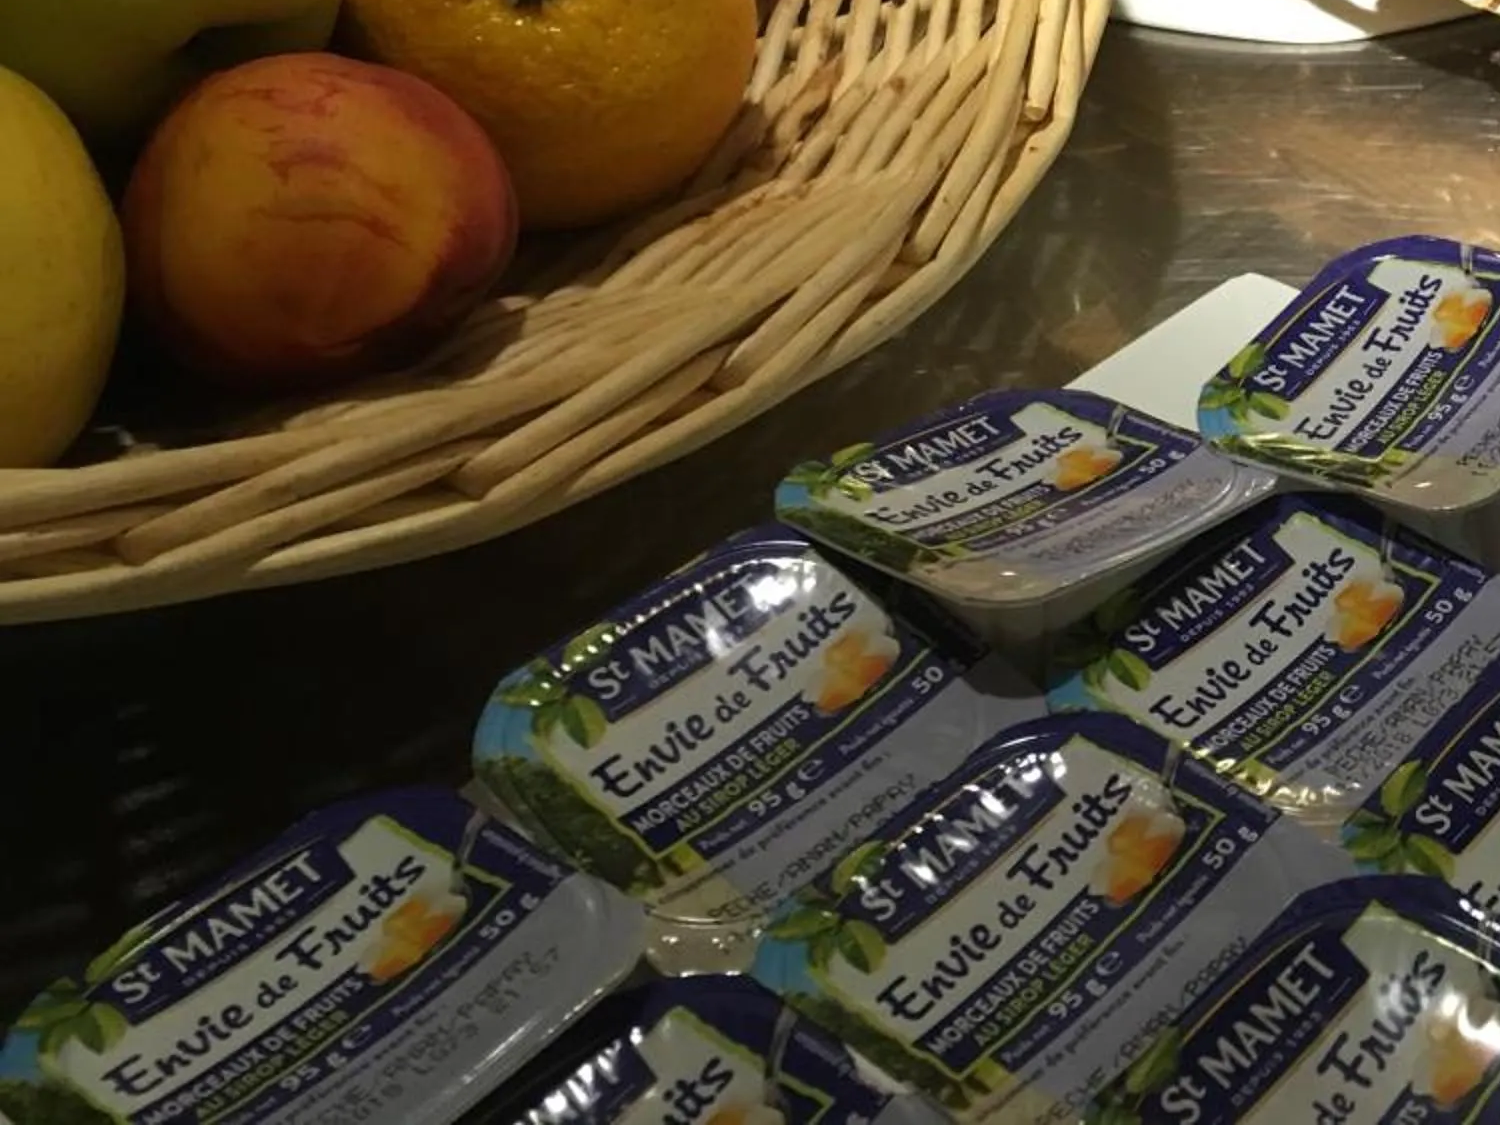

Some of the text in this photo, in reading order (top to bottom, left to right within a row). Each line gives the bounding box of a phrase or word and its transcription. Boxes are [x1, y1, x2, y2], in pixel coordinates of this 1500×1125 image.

[1258, 287, 1367, 391] St MAMET
[1363, 275, 1440, 354] Fruits
[1364, 354, 1392, 377] de
[1296, 379, 1371, 440] Envie
[1344, 401, 1400, 454] MORCEAUX
[1392, 383, 1414, 400] DE
[1404, 349, 1443, 386] FRUITS
[1424, 400, 1453, 423] 95
[890, 416, 1003, 468] MAMET
[975, 428, 1081, 481] Fruits
[872, 489, 967, 527] Envie
[968, 477, 998, 494] de
[1123, 539, 1268, 652] St MAMET
[1250, 547, 1352, 638] Fruits
[1423, 598, 1457, 628] 50
[586, 655, 629, 697] St
[1247, 636, 1279, 664] de
[1268, 678, 1295, 701] DE
[1285, 643, 1336, 686] FRUITS
[593, 592, 854, 796] Envie de Fruits
[910, 662, 947, 697] 50
[1152, 659, 1249, 728] Envie
[1298, 710, 1332, 739] 95
[634, 764, 728, 833] MORCEAUX
[727, 743, 754, 771] DE
[749, 703, 809, 754] FRUITS
[747, 785, 784, 820] 95
[1413, 789, 1452, 831] St
[860, 873, 904, 919] St
[906, 770, 1036, 885] MAMET
[1008, 775, 1130, 894] Fruits
[1201, 834, 1239, 872] 50
[112, 854, 324, 1004] St MAMET
[275, 857, 423, 973] Fruits
[477, 910, 520, 947] 50
[1000, 891, 1036, 928] de
[254, 971, 297, 1007] de
[880, 923, 999, 1017] Envie
[930, 971, 1022, 1053] MORCEAUX
[1018, 946, 1047, 975] DE
[1040, 897, 1100, 955] FRUITS
[1046, 985, 1085, 1024] 95
[110, 1004, 250, 1094] Envie
[153, 1047, 262, 1125] MORCEAUX
[263, 1023, 295, 1050] DE
[290, 975, 360, 1031] FRUITS
[1160, 941, 1335, 1125] St MAMET
[280, 1058, 323, 1095] 95
